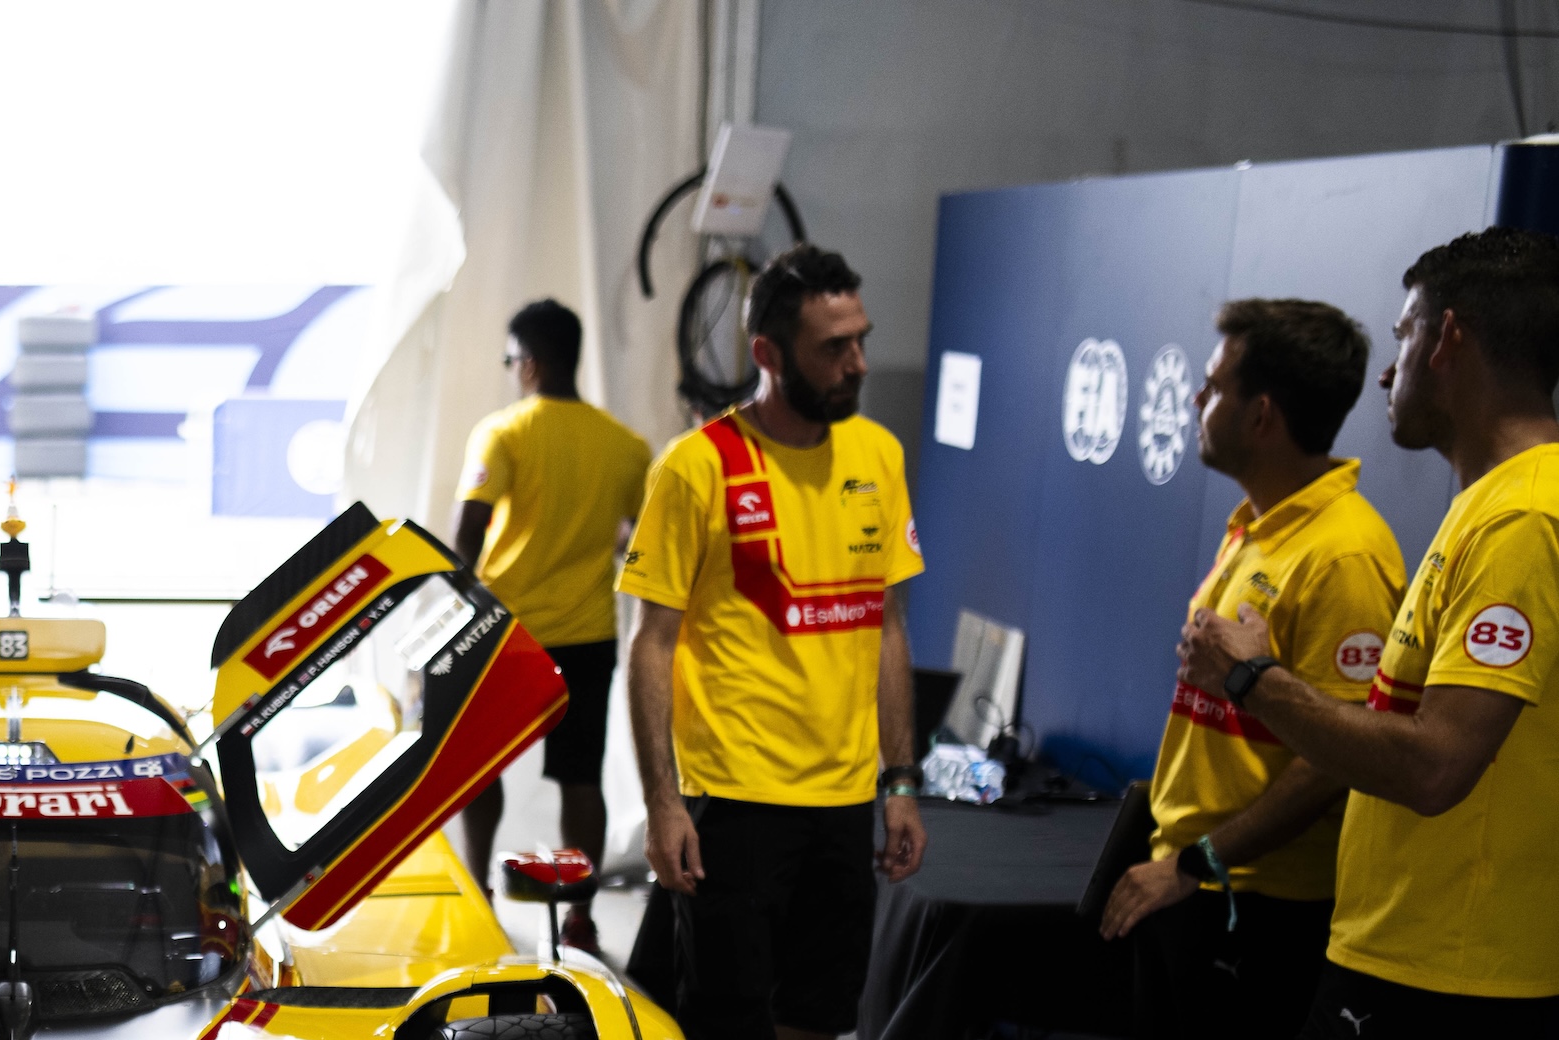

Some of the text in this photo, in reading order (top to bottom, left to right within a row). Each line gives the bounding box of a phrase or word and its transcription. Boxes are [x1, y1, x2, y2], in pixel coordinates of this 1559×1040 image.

[298, 565, 370, 628] ORLEN
[454, 606, 507, 656] NATZKA
[1470, 622, 1525, 651] 83
[0, 633, 28, 658] 83
[1341, 645, 1381, 667] 83
[25, 764, 124, 780] POZZI
